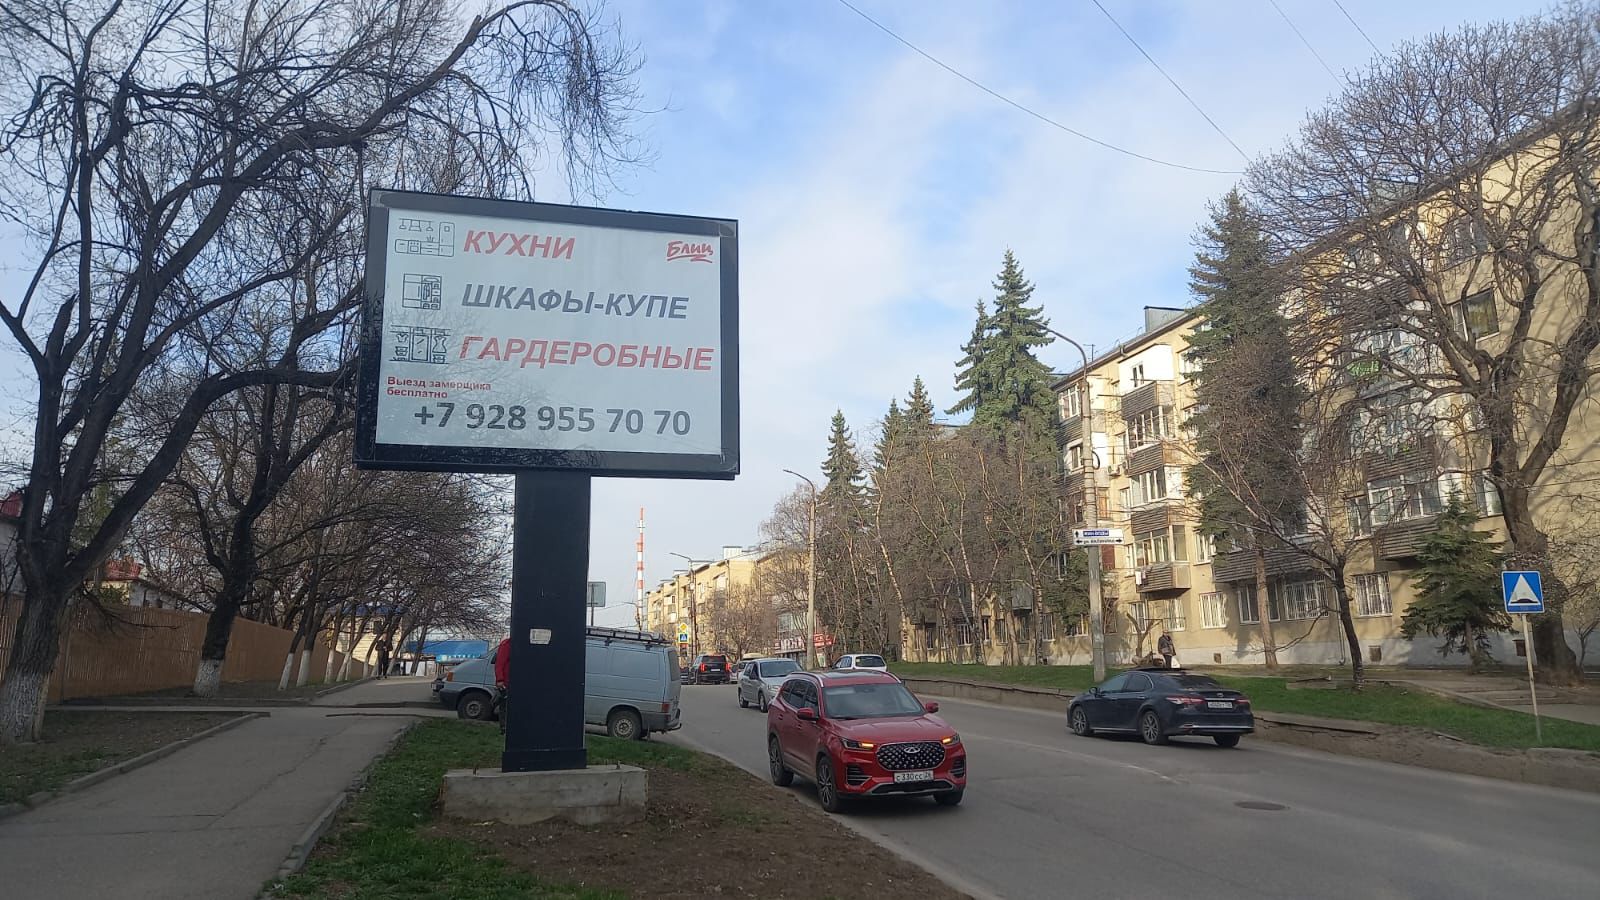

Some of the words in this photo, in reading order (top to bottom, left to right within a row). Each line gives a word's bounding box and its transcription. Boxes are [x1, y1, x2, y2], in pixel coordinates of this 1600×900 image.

[464, 230, 576, 260] КУХНИ
[667, 240, 713, 259] Блиц
[461, 283, 690, 319] ШКАФЫ-КУПЕ
[459, 336, 714, 371] ГАРДЕРОБНЫЕ
[387, 376, 426, 388] Выезд
[429, 380, 492, 391] замерщика
[387, 386, 448, 398] бесплатно
[414, 402, 455, 428] +7
[466, 403, 527, 431] 928
[537, 406, 595, 432] 955
[606, 408, 643, 434] 70
[654, 410, 691, 435] 70
